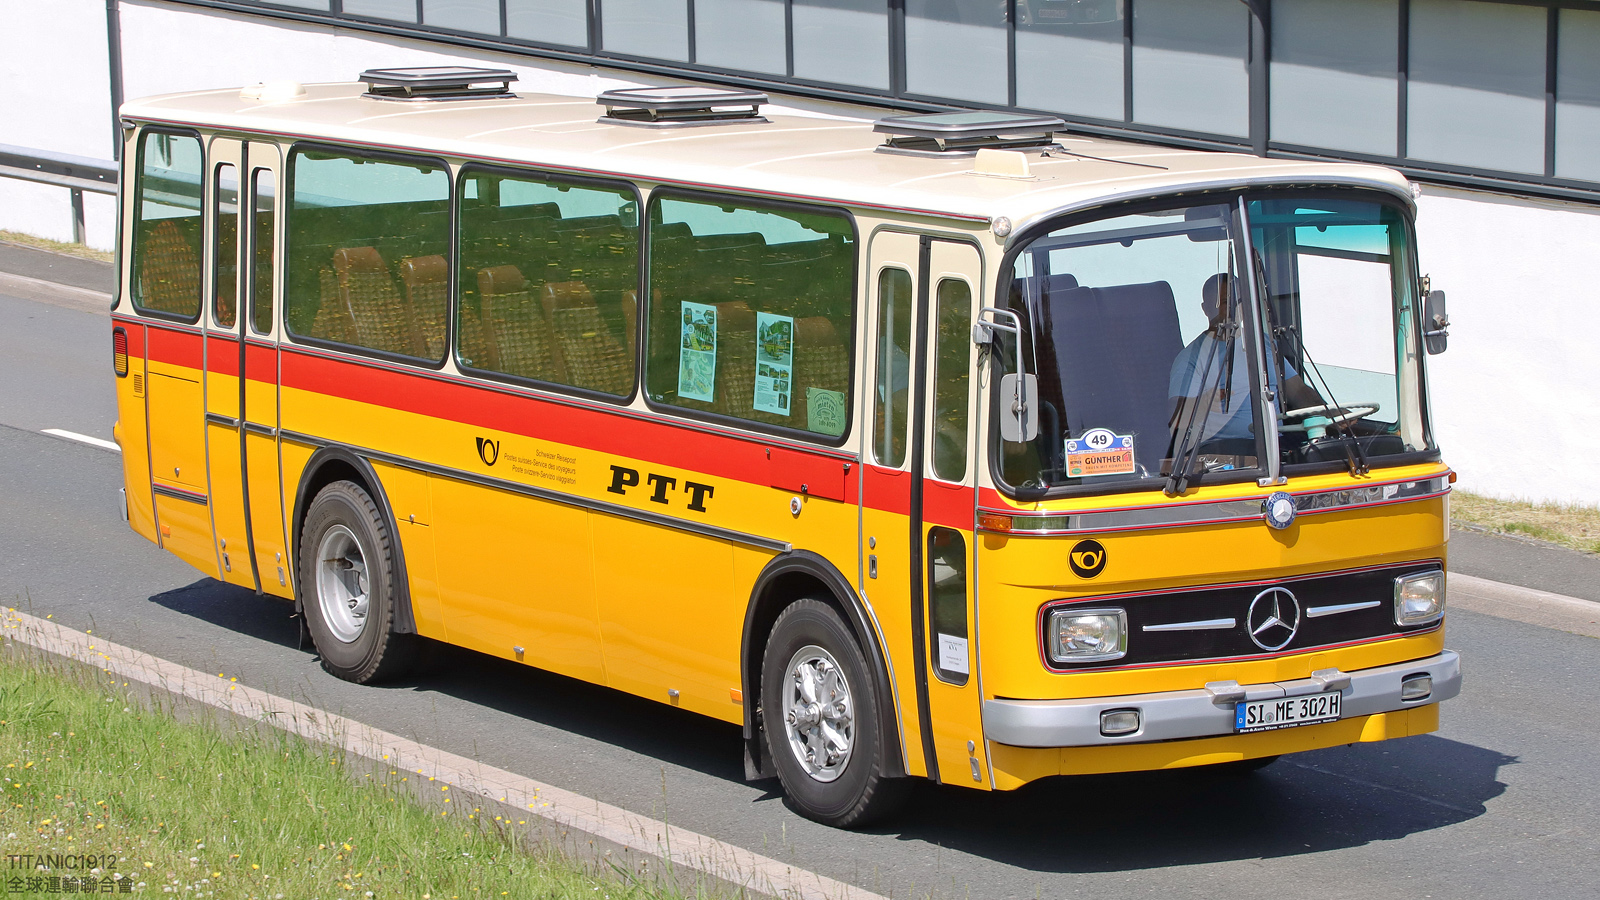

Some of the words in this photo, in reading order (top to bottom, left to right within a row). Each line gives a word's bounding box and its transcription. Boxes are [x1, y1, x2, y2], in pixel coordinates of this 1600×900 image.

[1091, 435, 1107, 445] 49
[504, 453, 517, 463] Postes
[536, 449, 556, 459] Schweizer
[1085, 456, 1121, 464] GÜNTHER
[512, 464, 523, 473] Poste
[607, 465, 714, 513] PTT
[1247, 704, 1265, 725] SI
[1275, 701, 1295, 722] ME
